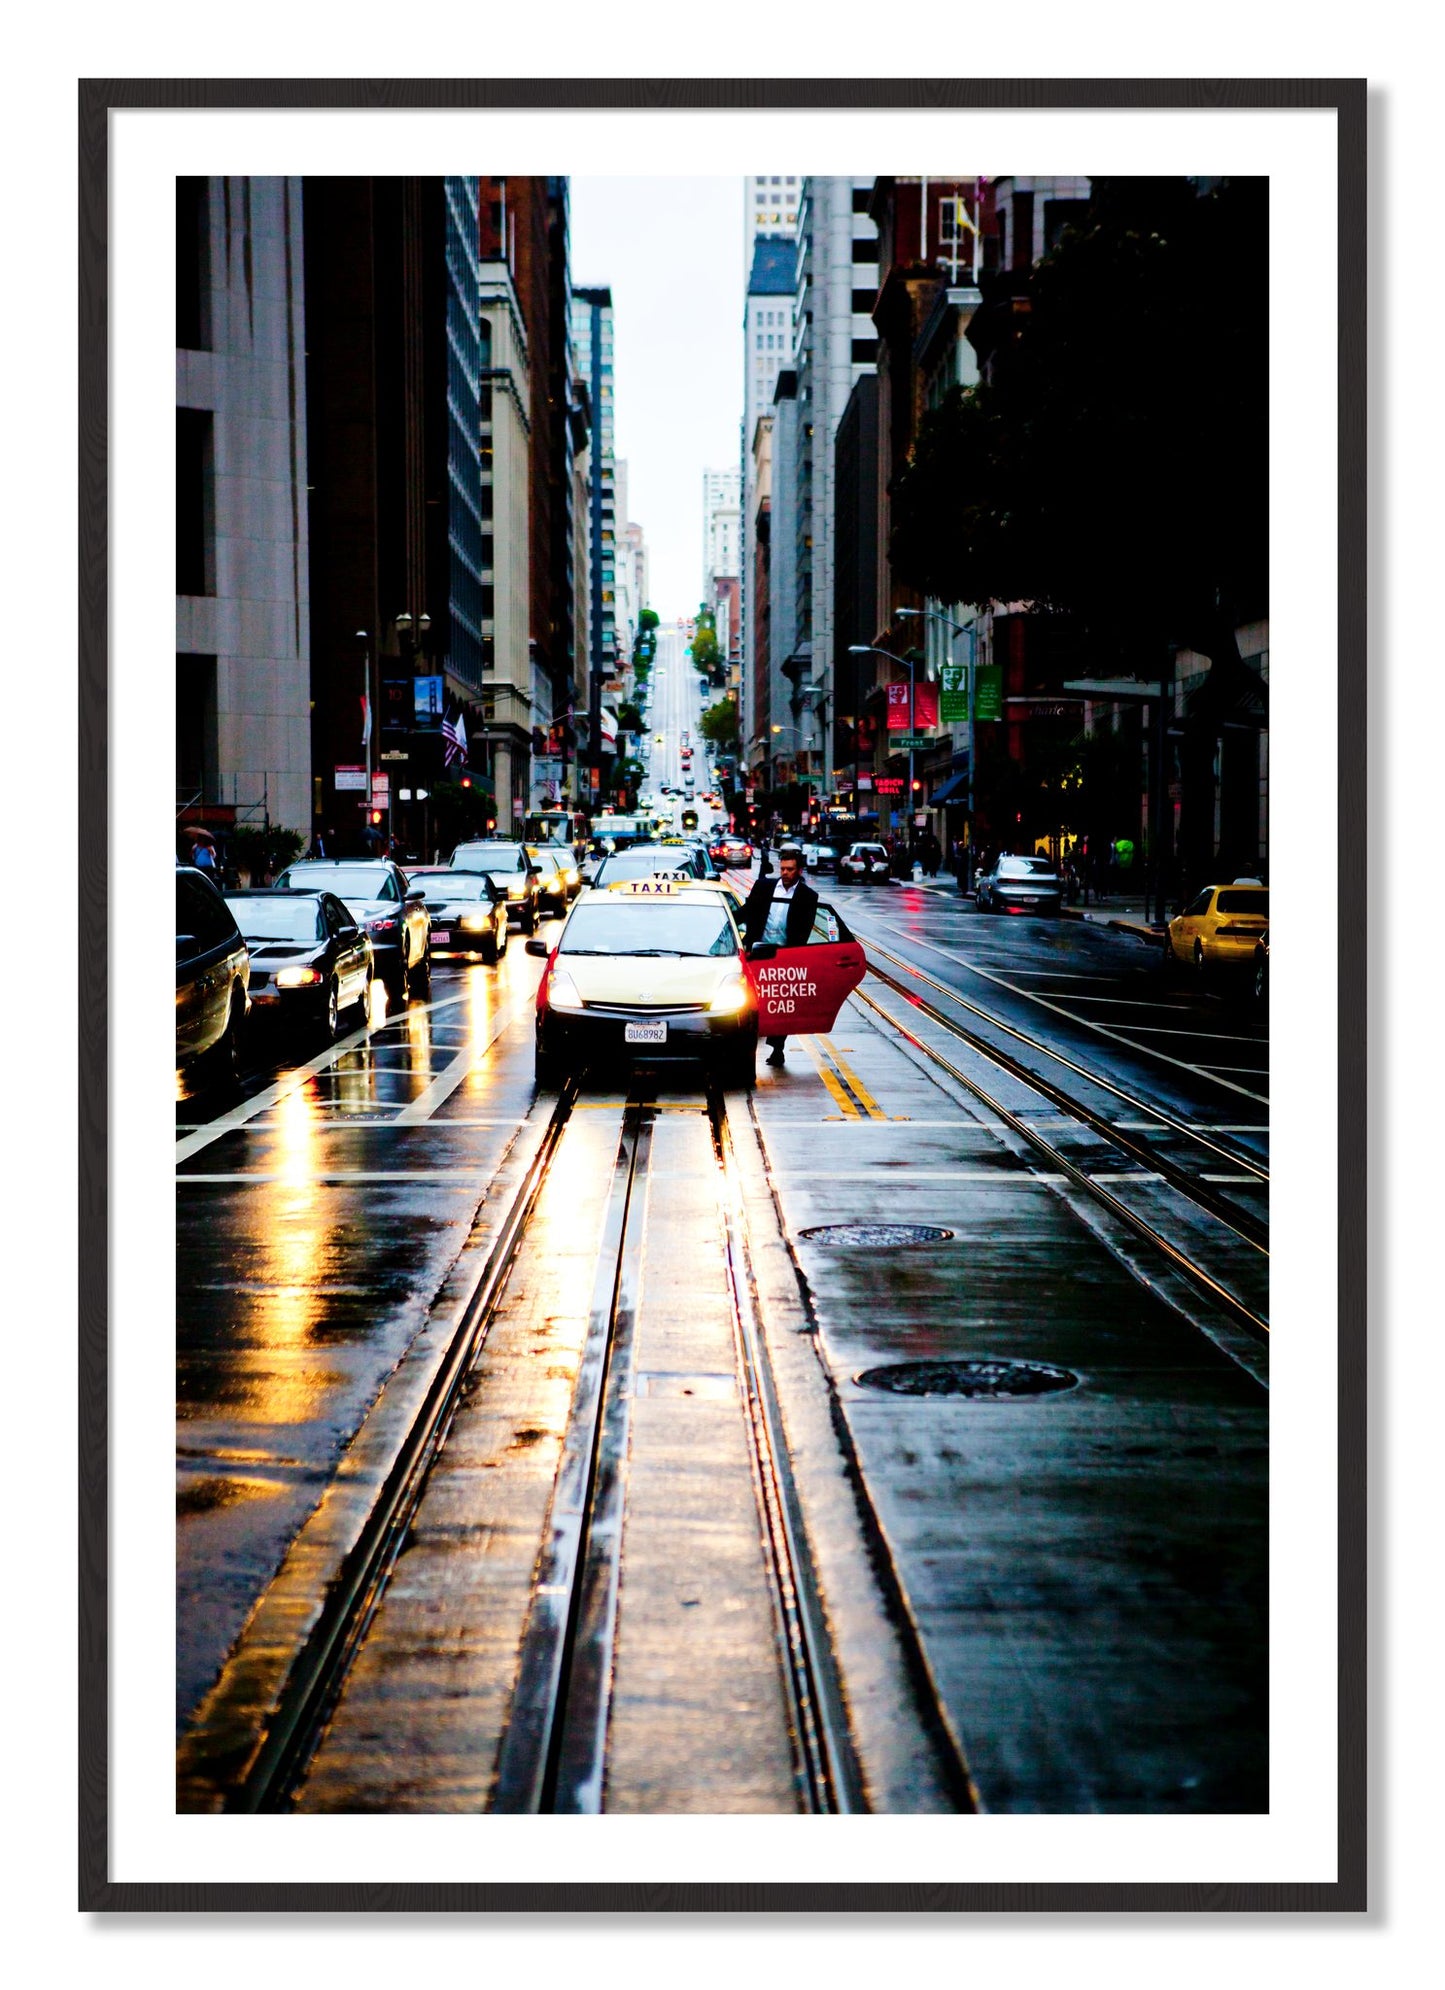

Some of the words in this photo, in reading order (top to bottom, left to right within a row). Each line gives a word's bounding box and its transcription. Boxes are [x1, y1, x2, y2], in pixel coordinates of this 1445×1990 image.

[900, 739, 924, 747] Front
[874, 778, 904, 787] TADICH
[653, 872, 686, 881] TAXI
[631, 883, 671, 893] TAXI
[758, 967, 808, 982] ARROW
[767, 1000, 796, 1014] CAB
